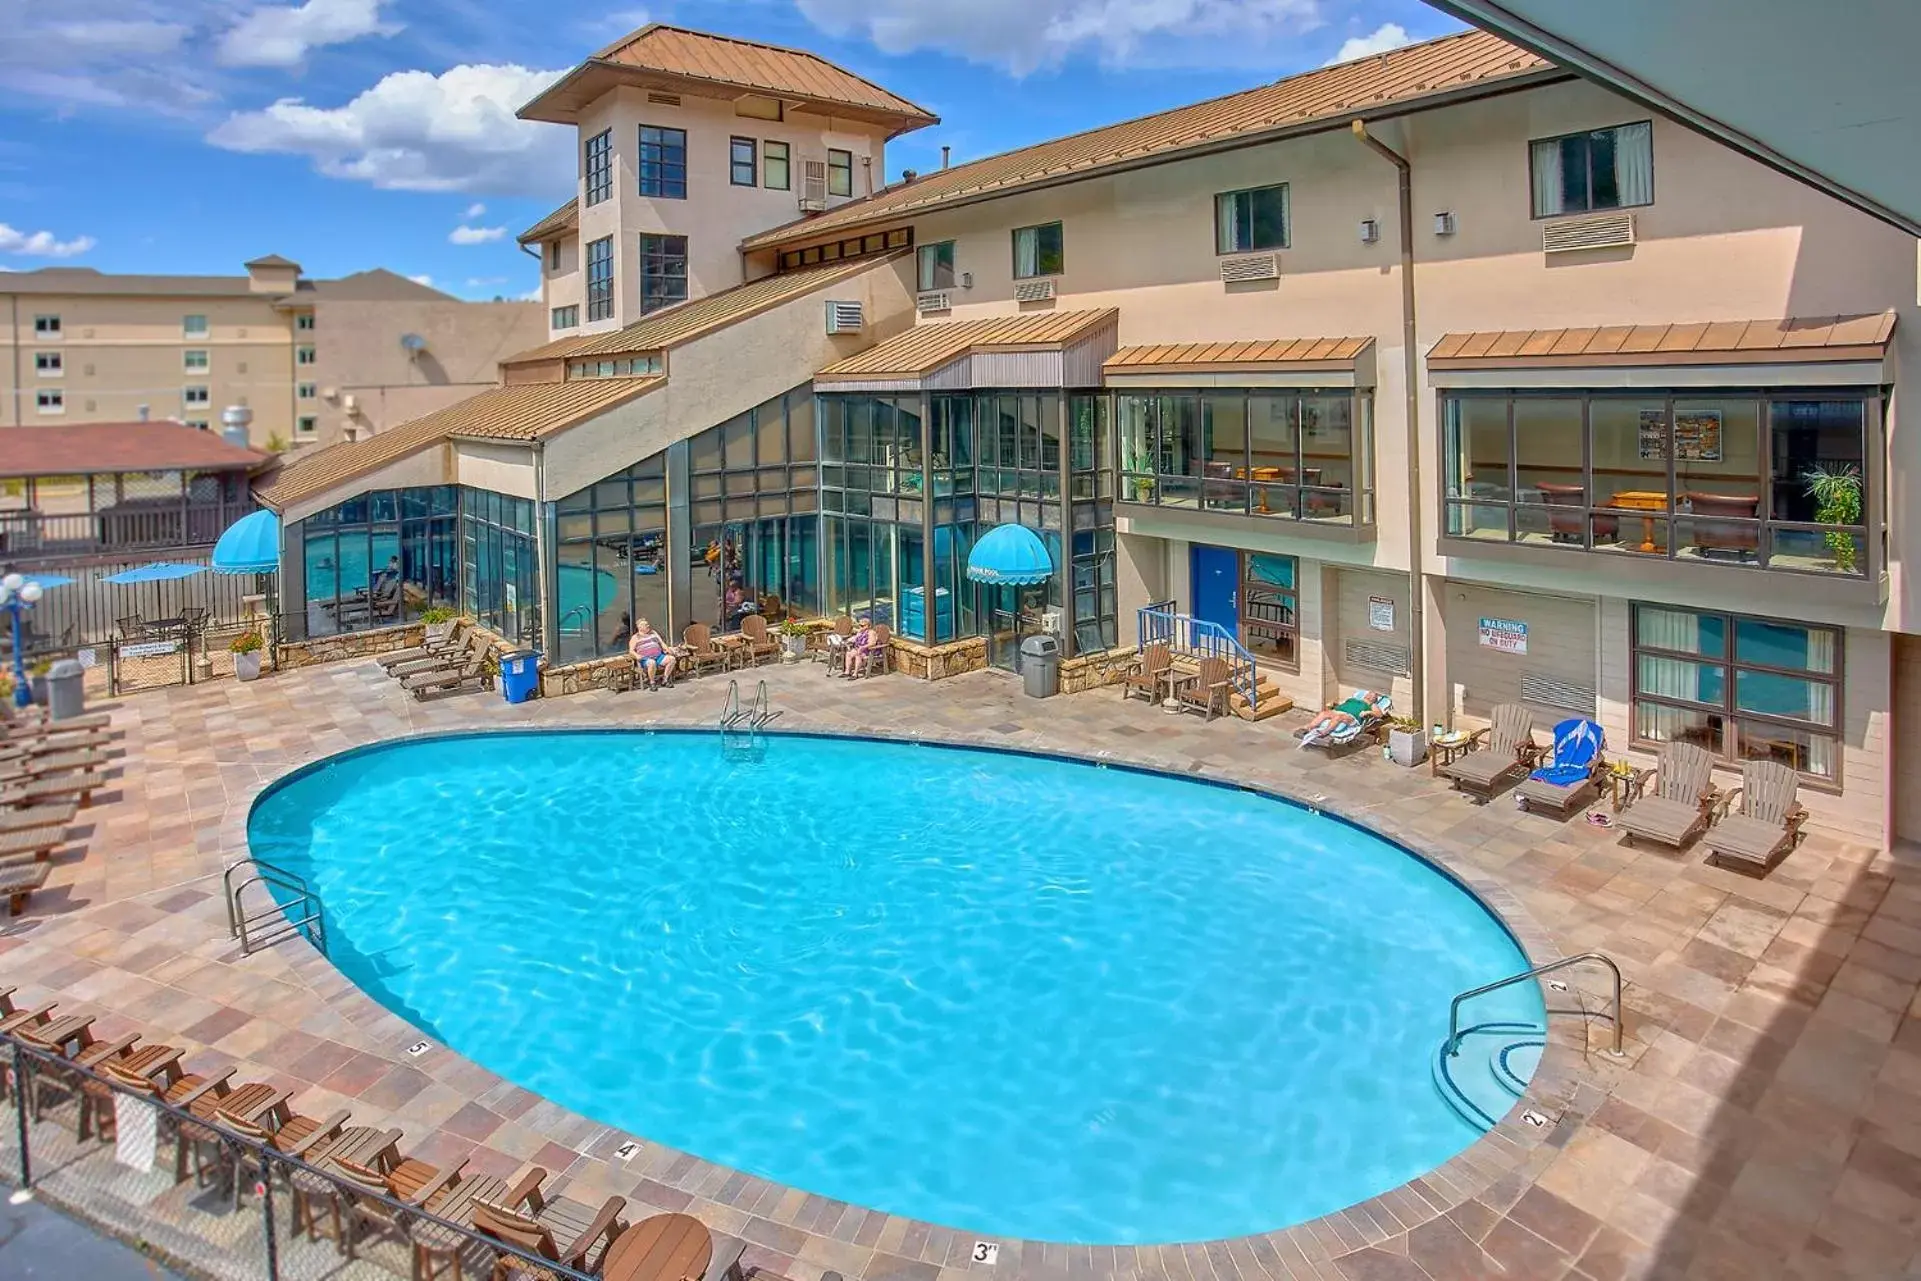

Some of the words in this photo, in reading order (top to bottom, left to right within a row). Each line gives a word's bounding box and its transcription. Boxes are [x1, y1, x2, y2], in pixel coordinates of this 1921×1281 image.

[1484, 619, 1524, 633] WARNING
[1481, 628, 1490, 637] NO
[1489, 637, 1498, 646] ON
[1500, 639, 1517, 648] DUTY
[1523, 1115, 1543, 1126] 2
[617, 1144, 636, 1157] 4
